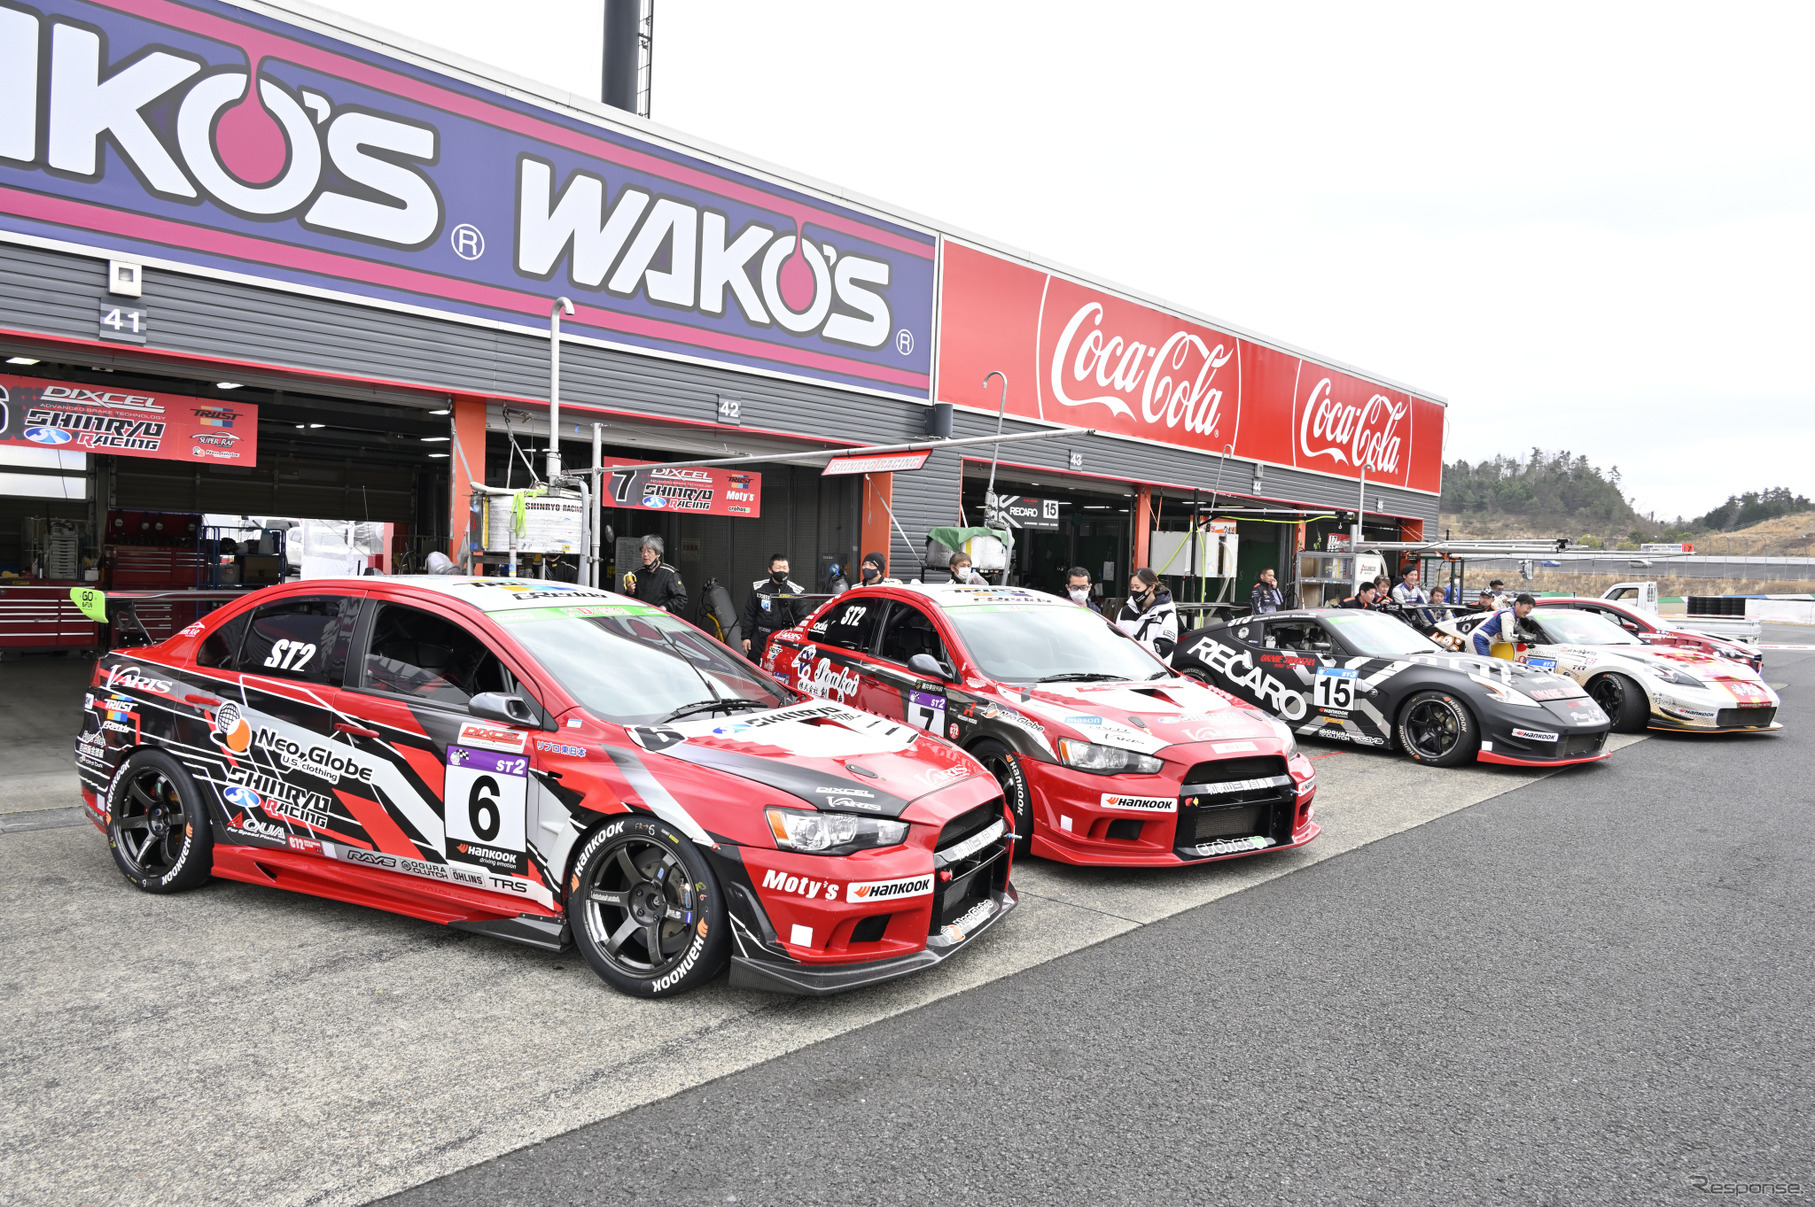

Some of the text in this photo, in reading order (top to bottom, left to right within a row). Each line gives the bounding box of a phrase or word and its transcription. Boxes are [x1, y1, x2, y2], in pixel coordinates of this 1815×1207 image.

[518, 158, 892, 348] WAKO'S
[103, 308, 141, 333] 41
[1051, 301, 1233, 436] Coca-Cola
[42, 386, 165, 412] DIXCEL
[190, 409, 243, 420] TRUST
[720, 401, 739, 417] 42
[25, 410, 165, 438] SHINRYO
[1300, 376, 1408, 474] Coca-Cola
[1070, 454, 1083, 467] 43
[612, 464, 637, 502] 7
[644, 484, 714, 502] SHINRYO
[726, 490, 756, 502] Moty's
[525, 502, 560, 511] SHINRYO
[1010, 507, 1038, 517] RECARO
[1045, 502, 1057, 516] 15
[82, 591, 94, 601] GO
[840, 605, 867, 627] ST2
[264, 639, 316, 672] ST2
[1186, 635, 1307, 721] RECARO
[1319, 676, 1351, 708] 15
[104, 698, 138, 712] TRUST
[930, 698, 946, 709] ST2
[919, 707, 934, 731] 7
[461, 726, 523, 745] DIXCEL
[282, 755, 338, 782] U.S. clothing
[496, 759, 526, 774] ST2
[227, 766, 332, 816] SHINRYO
[816, 786, 875, 798] DIXCEL
[468, 775, 501, 842] 6
[347, 849, 396, 868] RAYS
[411, 861, 447, 873] OGURA
[479, 858, 517, 869] driving emotion
[412, 867, 449, 880] CLUTCH
[489, 876, 528, 893] TRS
[762, 869, 840, 900] Moty's
